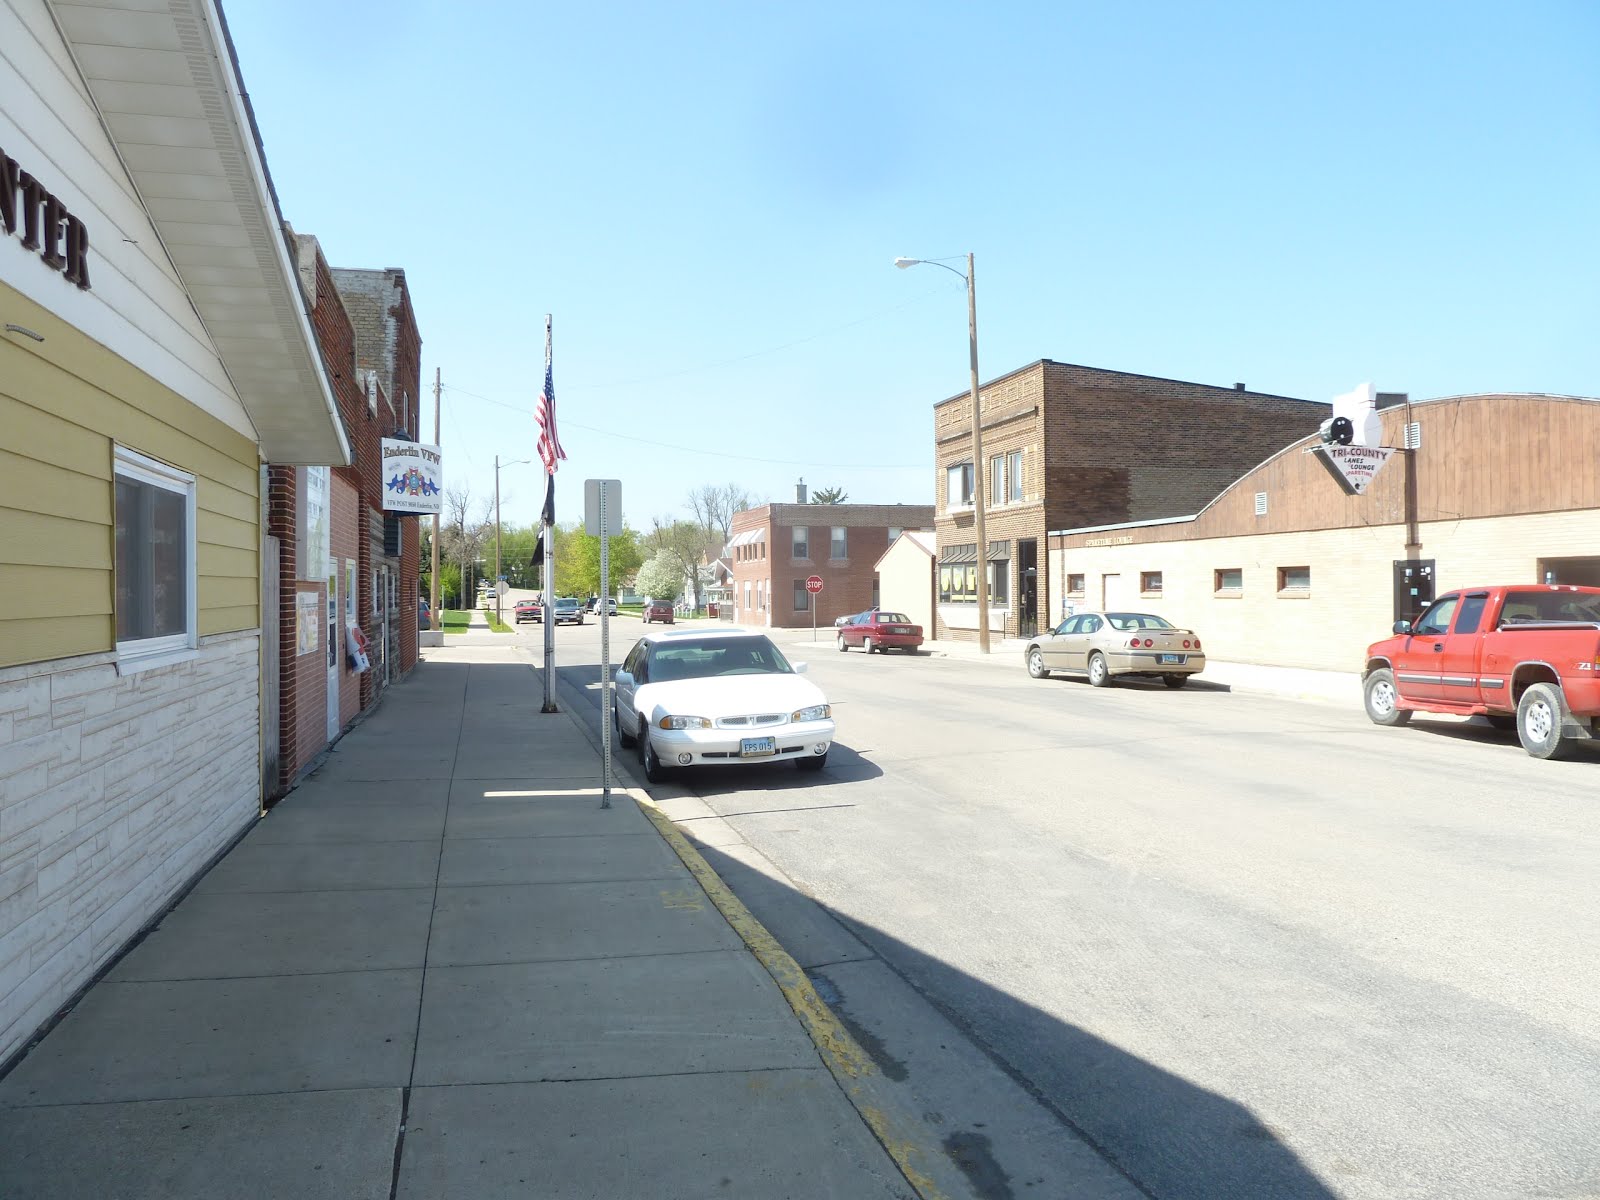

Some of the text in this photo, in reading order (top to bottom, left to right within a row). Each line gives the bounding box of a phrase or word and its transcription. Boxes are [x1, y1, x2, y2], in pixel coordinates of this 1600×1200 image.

[384, 446, 441, 465] Enderlin VFW
[1332, 448, 1388, 460] TRI-COUNTY
[807, 581, 822, 589] STOP
[744, 742, 772, 751] EPS 015
